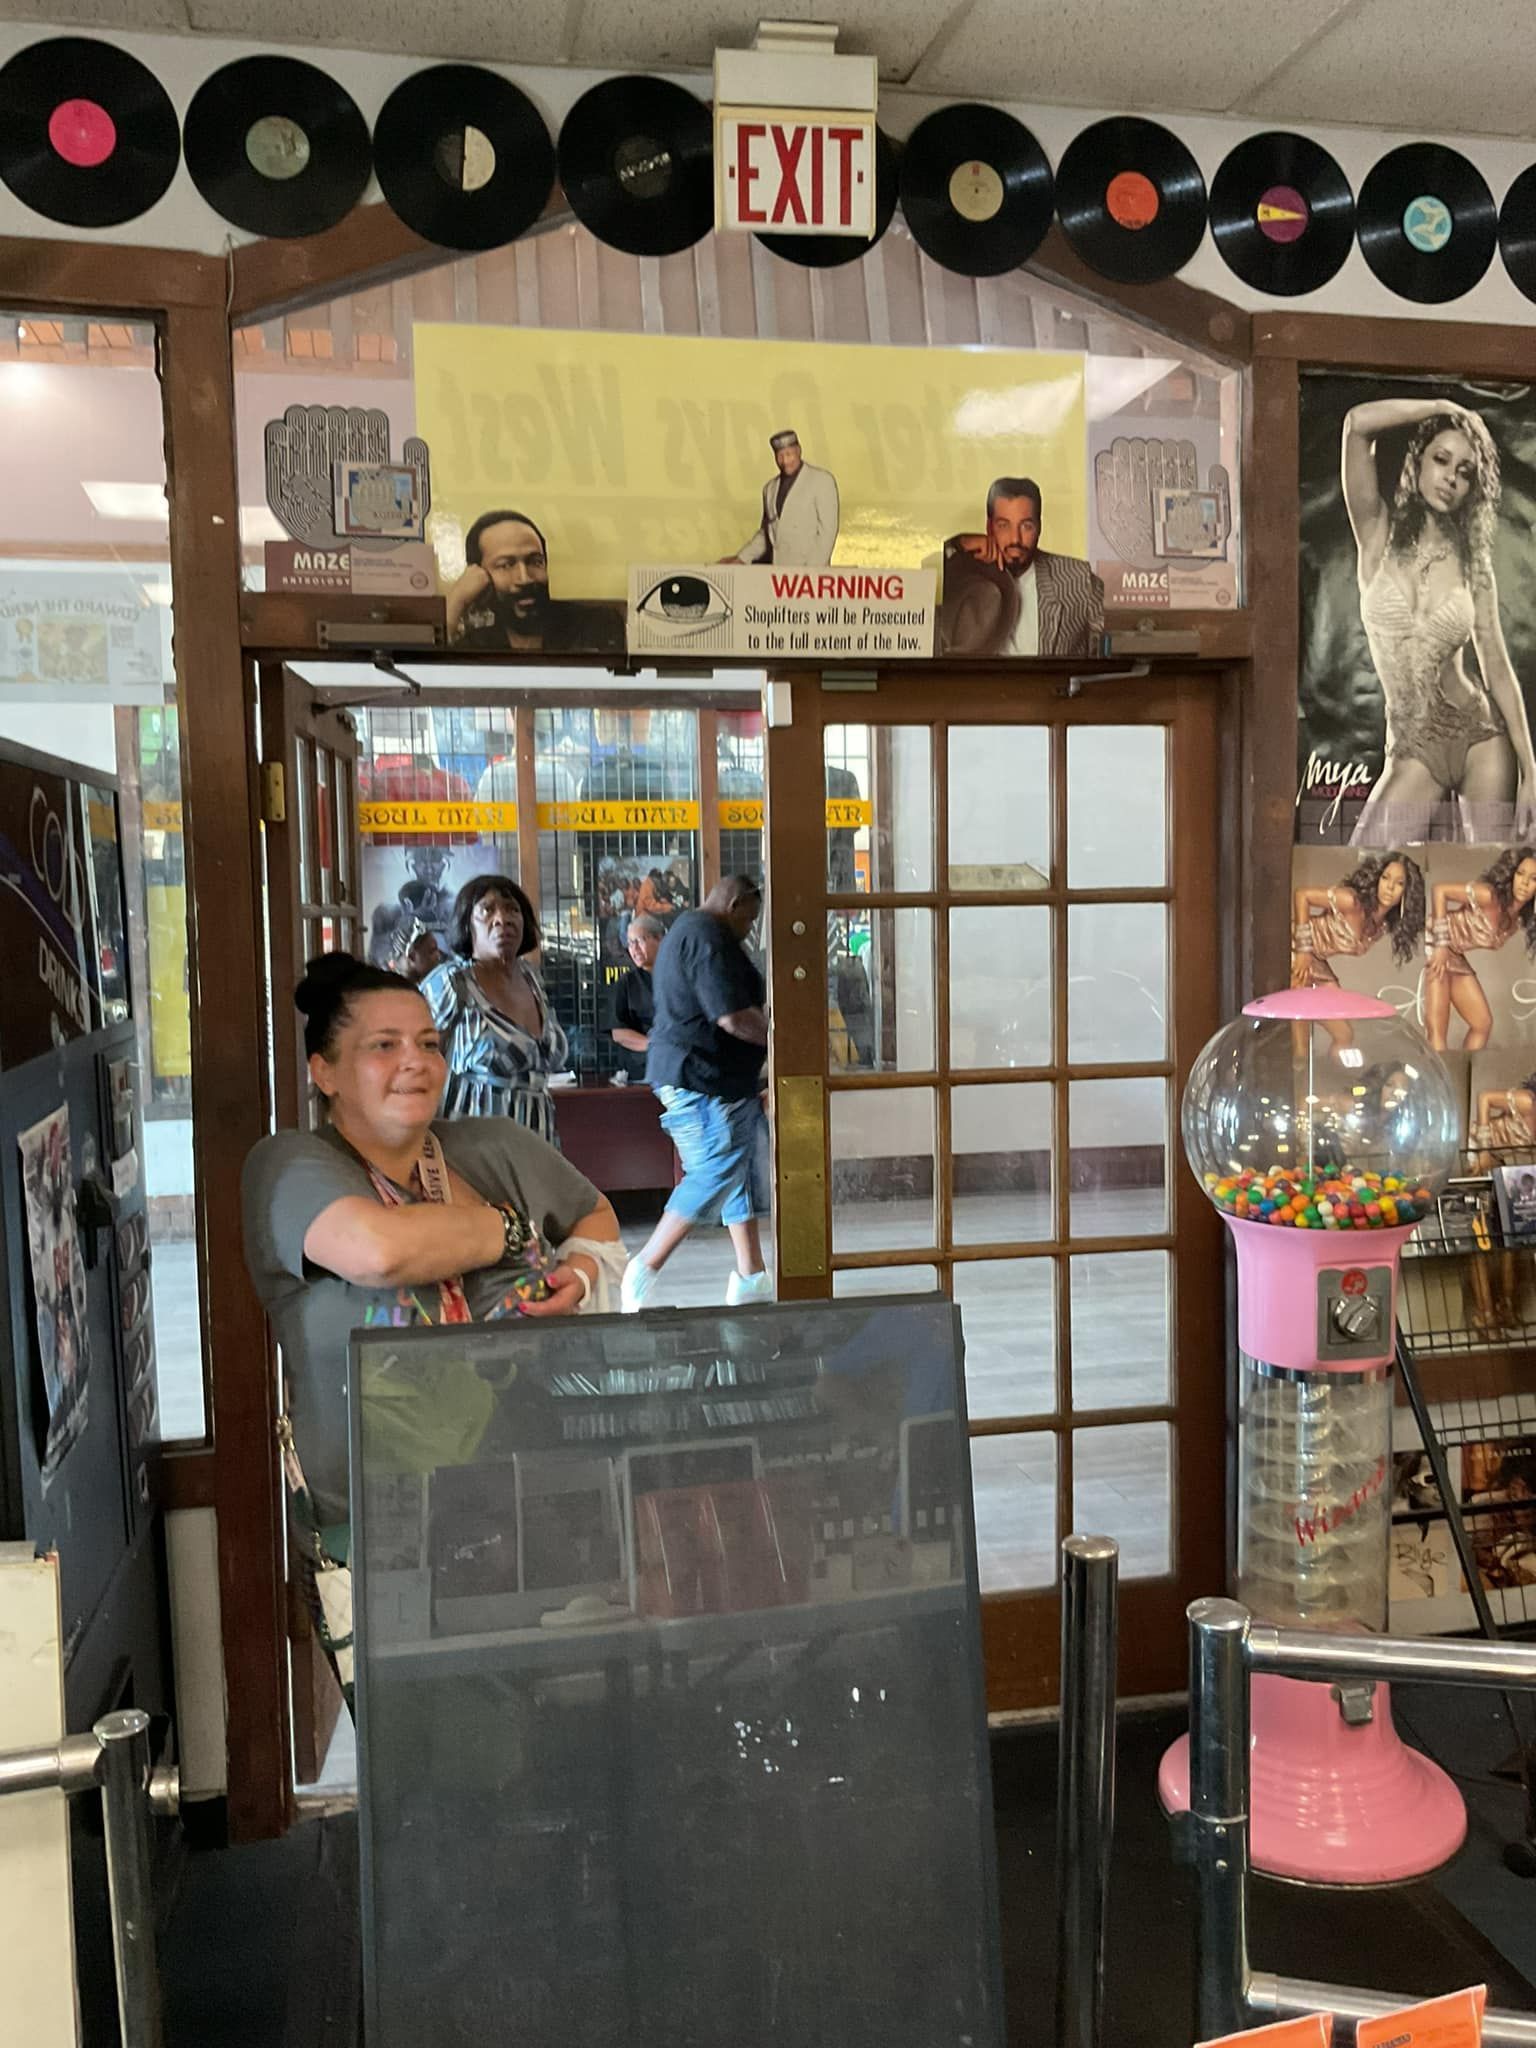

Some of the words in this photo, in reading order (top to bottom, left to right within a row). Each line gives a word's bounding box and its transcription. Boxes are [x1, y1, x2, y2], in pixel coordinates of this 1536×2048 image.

[737, 124, 864, 226] EXIT
[293, 551, 350, 571] MAZE
[282, 575, 350, 587] ANTHOLOGY
[771, 574, 904, 600] WARNING
[1122, 571, 1169, 589] MAZE
[744, 604, 811, 629] Shoplifters
[815, 606, 839, 626] will
[843, 606, 857, 626] be
[862, 606, 925, 626] Prosecuted
[748, 633, 760, 650] to
[766, 631, 785, 650] the
[790, 631, 809, 650] full
[814, 632, 851, 650] extent
[857, 631, 868, 650] of
[874, 631, 892, 650] the
[897, 631, 921, 650] law.
[359, 807, 428, 826] SOUL
[727, 806, 763, 824] SO
[38, 936, 87, 1034] DRINKS
